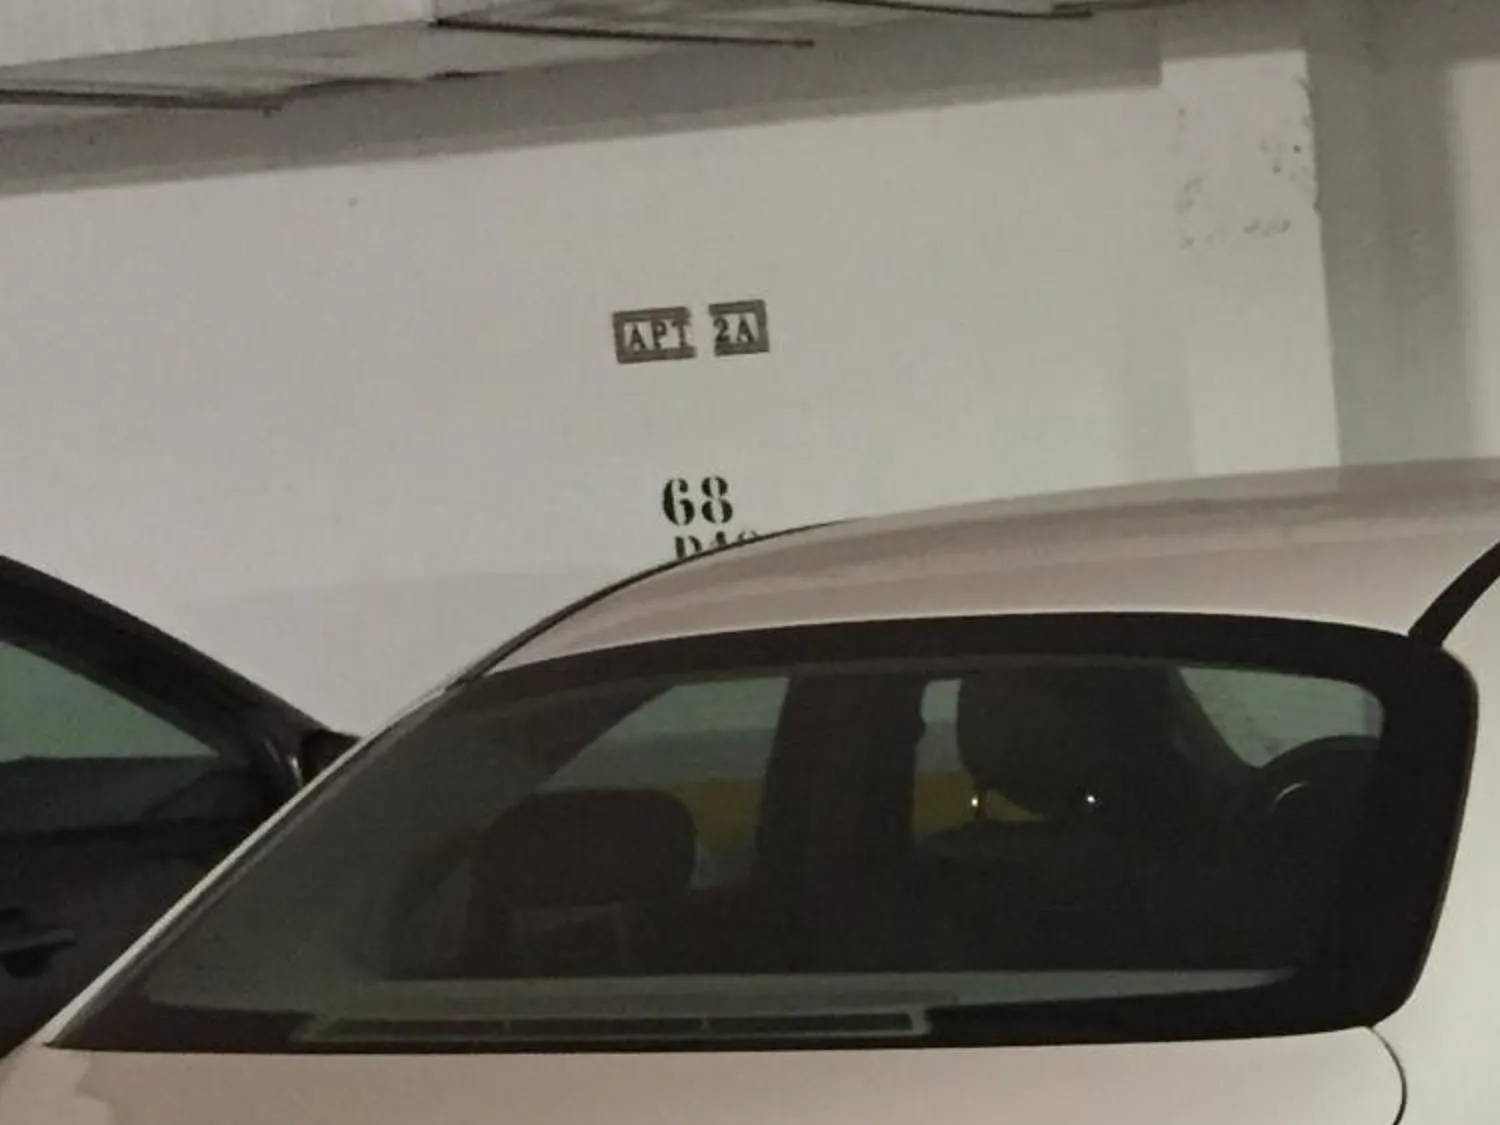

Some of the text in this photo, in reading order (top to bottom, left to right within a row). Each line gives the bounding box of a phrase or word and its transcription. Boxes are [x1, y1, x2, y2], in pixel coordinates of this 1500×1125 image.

[628, 316, 756, 350] APT 2A
[662, 475, 733, 526] 68
